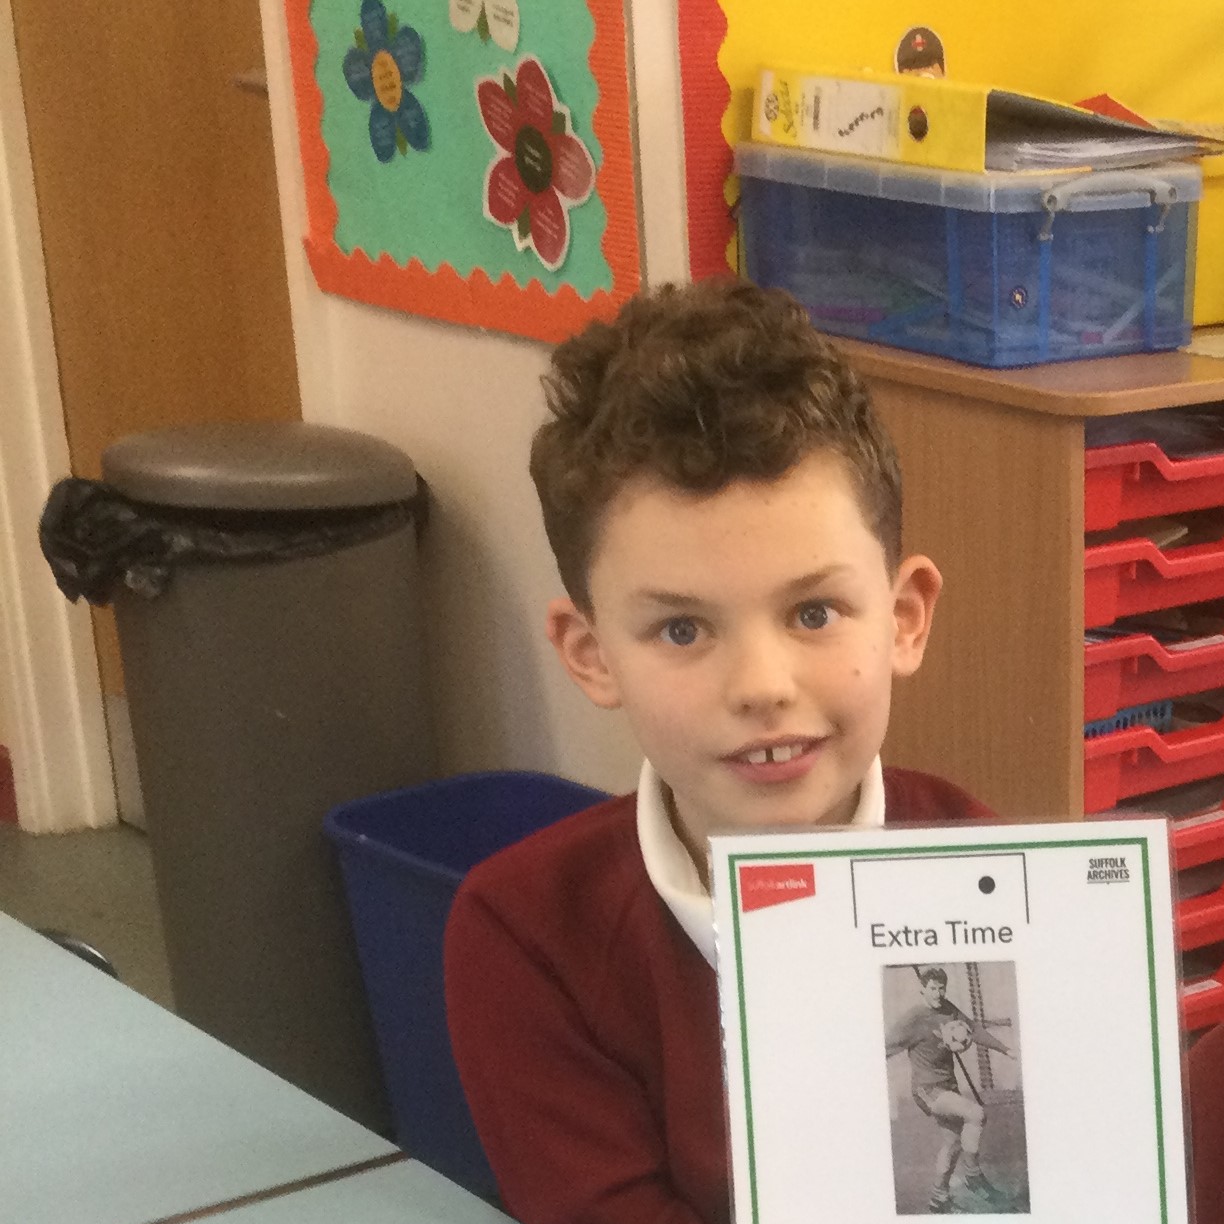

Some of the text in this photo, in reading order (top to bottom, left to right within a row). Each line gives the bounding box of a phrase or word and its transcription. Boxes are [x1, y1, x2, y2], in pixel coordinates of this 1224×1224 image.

[1088, 857, 1127, 869] SUFFOLK
[1087, 869, 1130, 881] ARCHIVES
[870, 920, 1013, 948] Extra Time
